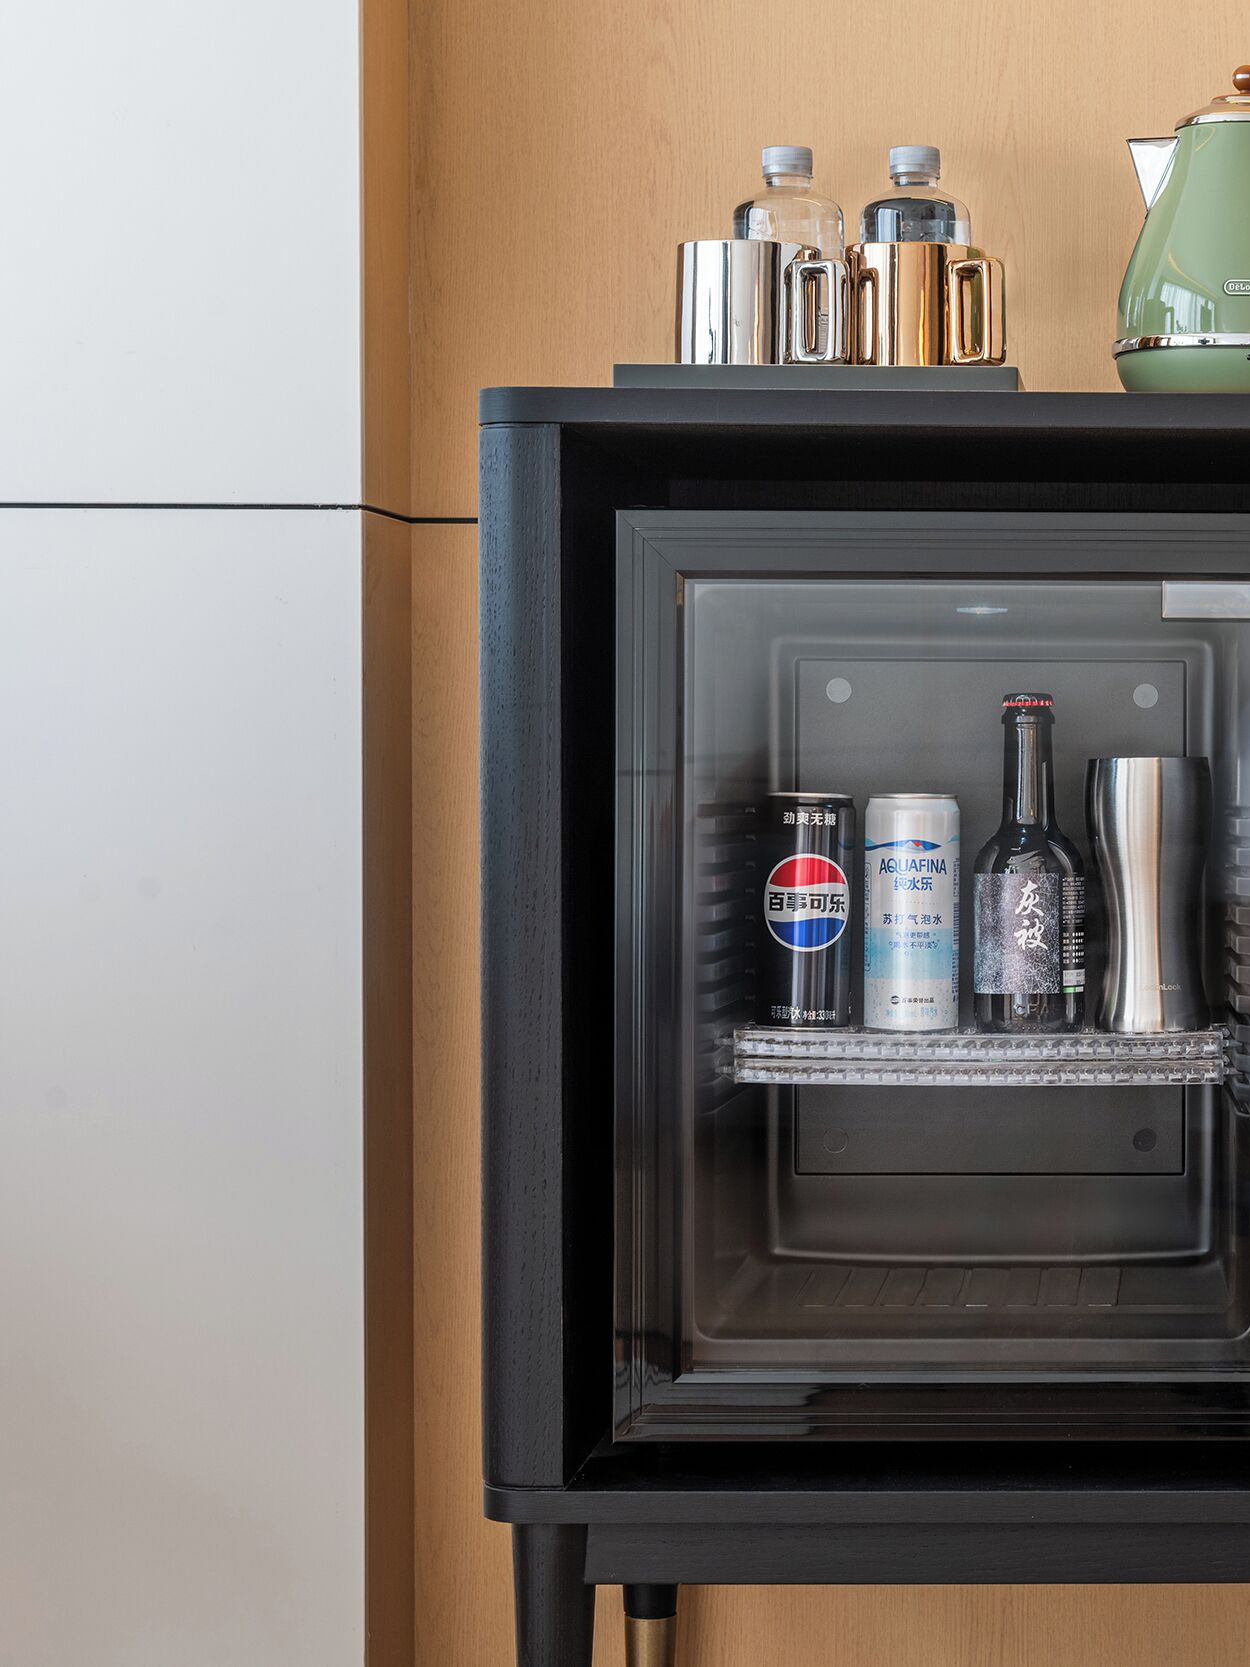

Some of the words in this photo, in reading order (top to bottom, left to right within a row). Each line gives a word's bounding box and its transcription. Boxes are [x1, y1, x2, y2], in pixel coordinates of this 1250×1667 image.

[783, 811, 837, 826] 劲爽无糖
[879, 858, 947, 876] AQUAFINA
[893, 876, 933, 891] 纯水乐
[768, 891, 845, 913] 百事可乐
[882, 913, 943, 926] 苏打气泡水
